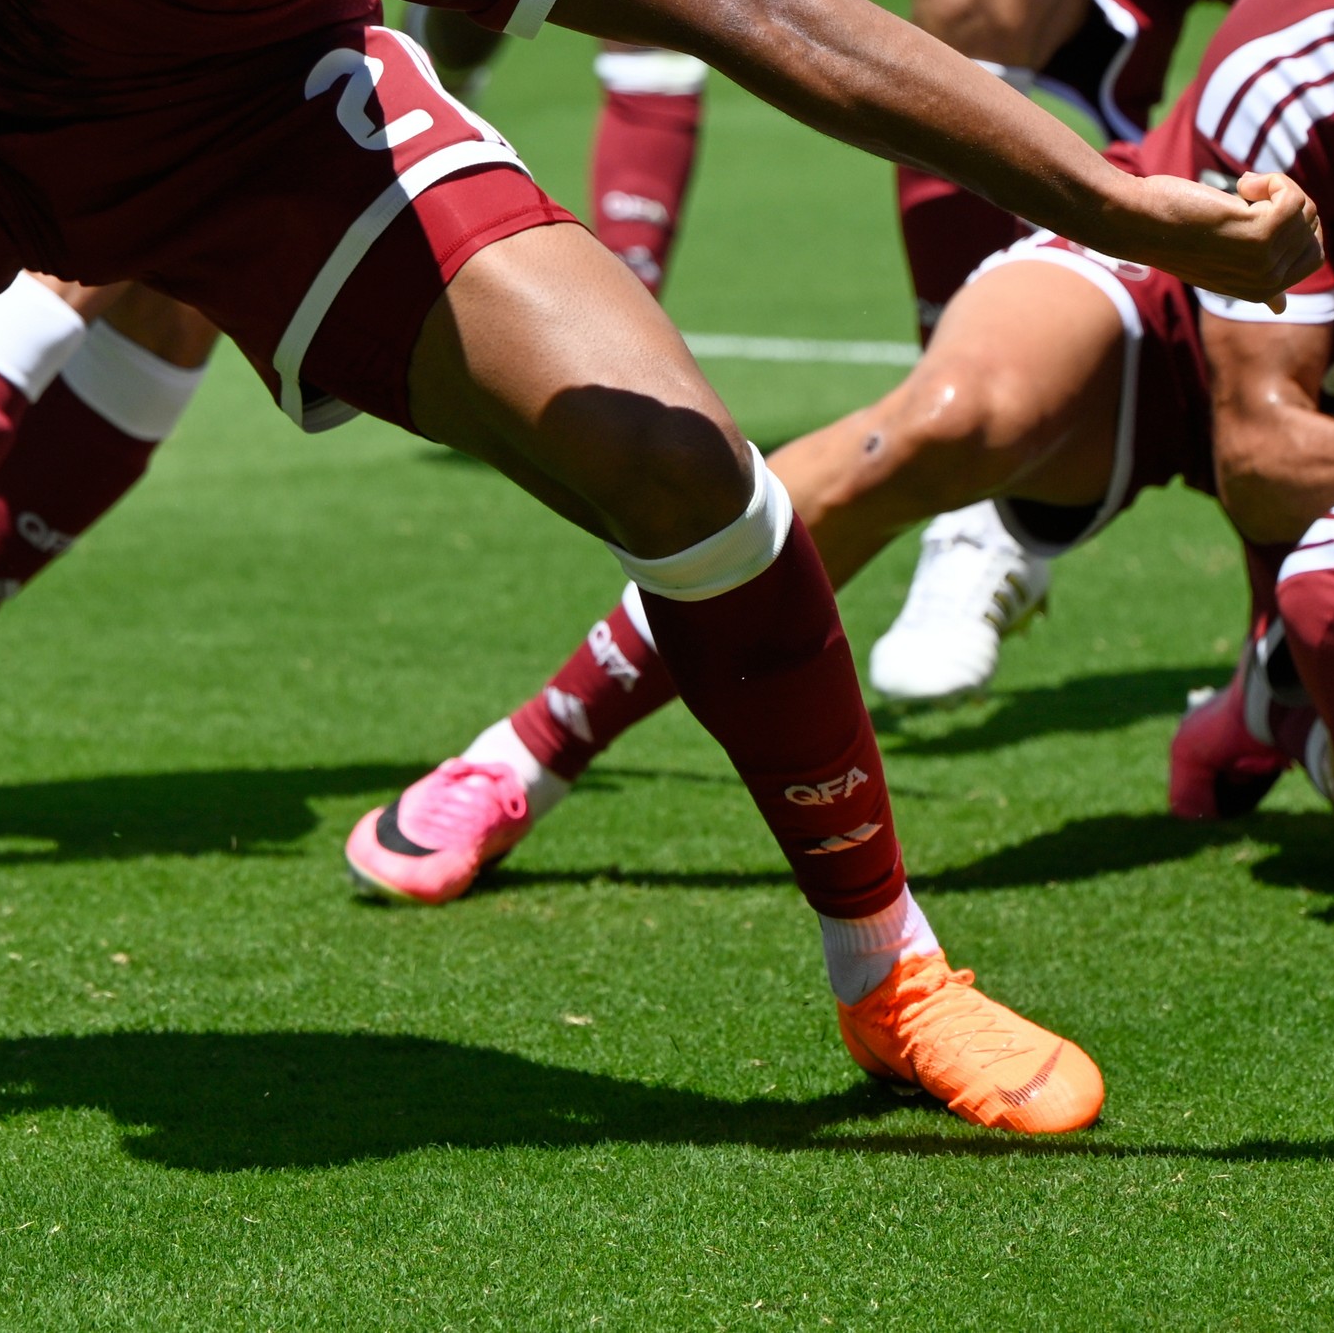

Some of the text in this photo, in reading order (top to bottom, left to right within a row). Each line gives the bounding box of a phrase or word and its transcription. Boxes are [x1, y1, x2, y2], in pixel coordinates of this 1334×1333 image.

[304, 47, 434, 151] 2
[16, 511, 76, 554] QF
[784, 766, 869, 806] QFA
